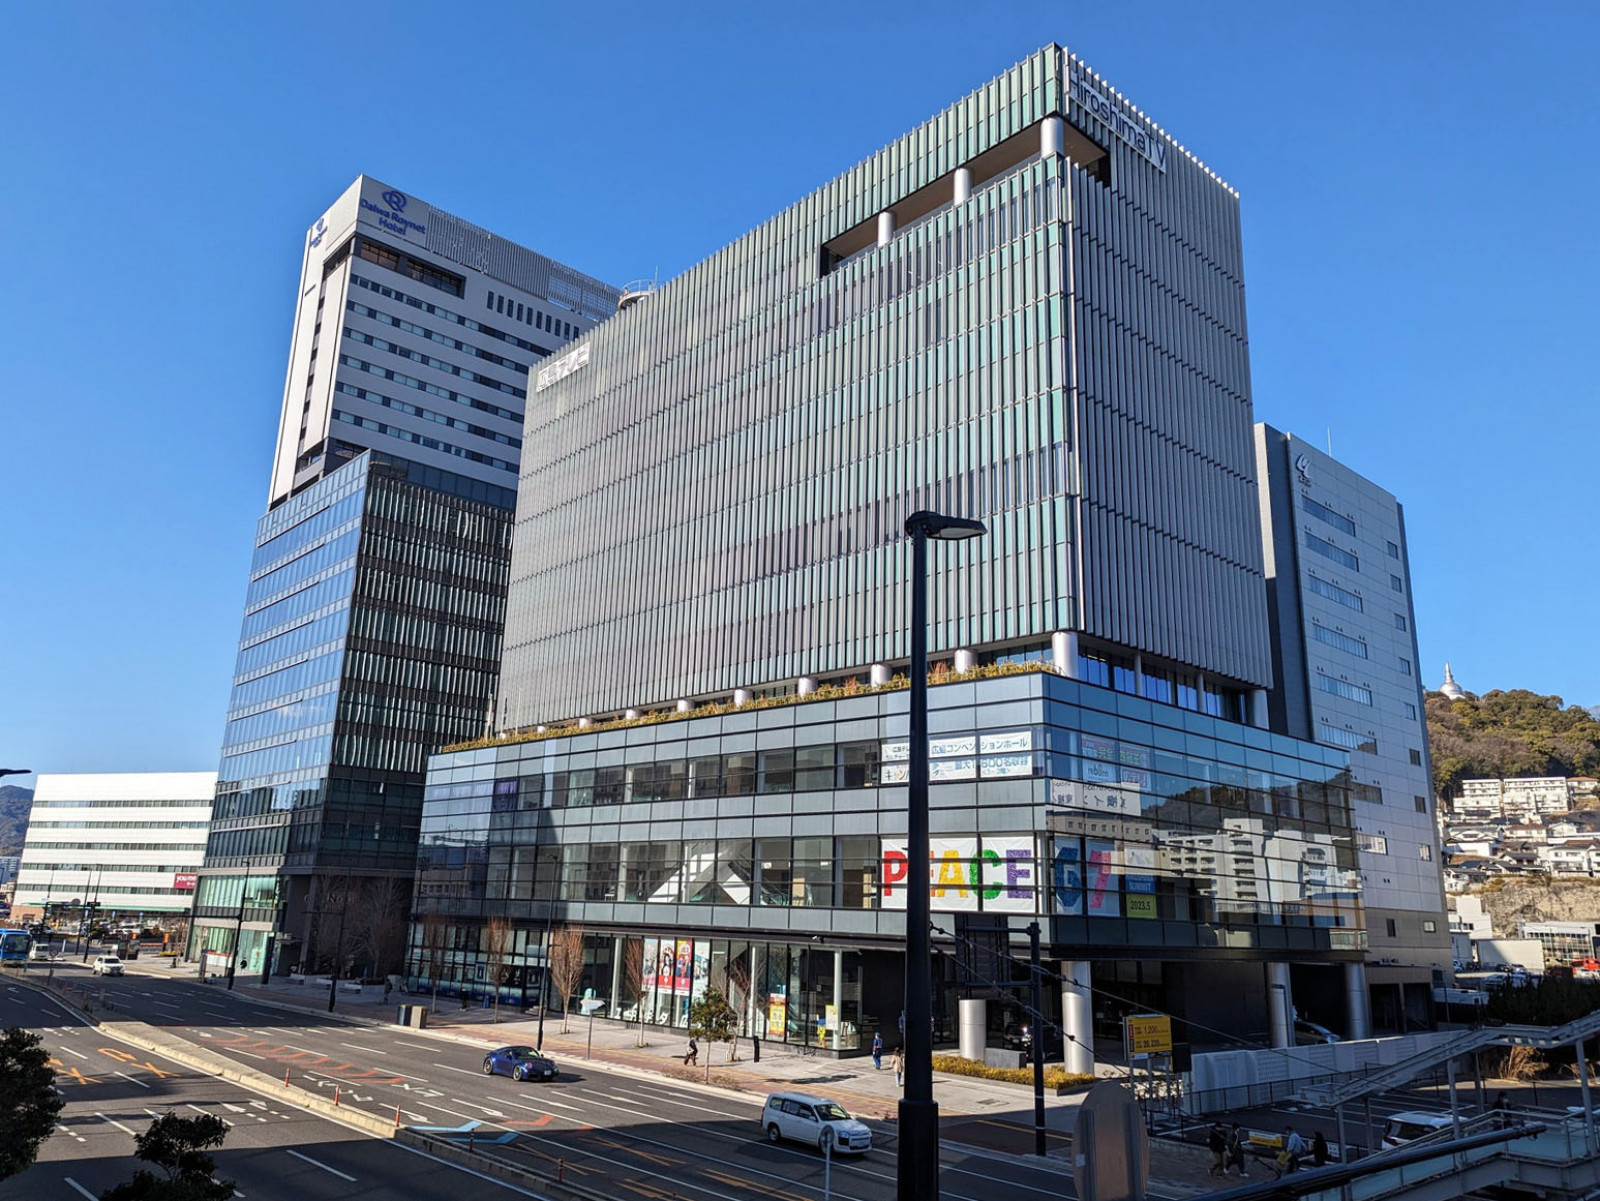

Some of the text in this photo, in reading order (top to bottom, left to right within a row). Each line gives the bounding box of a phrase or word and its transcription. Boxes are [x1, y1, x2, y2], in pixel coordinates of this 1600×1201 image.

[360, 199, 426, 234] Daiwa Roynet
[379, 217, 406, 235] Hotel
[884, 850, 1033, 900] PACE
[1130, 900, 1151, 911] 2023.5
